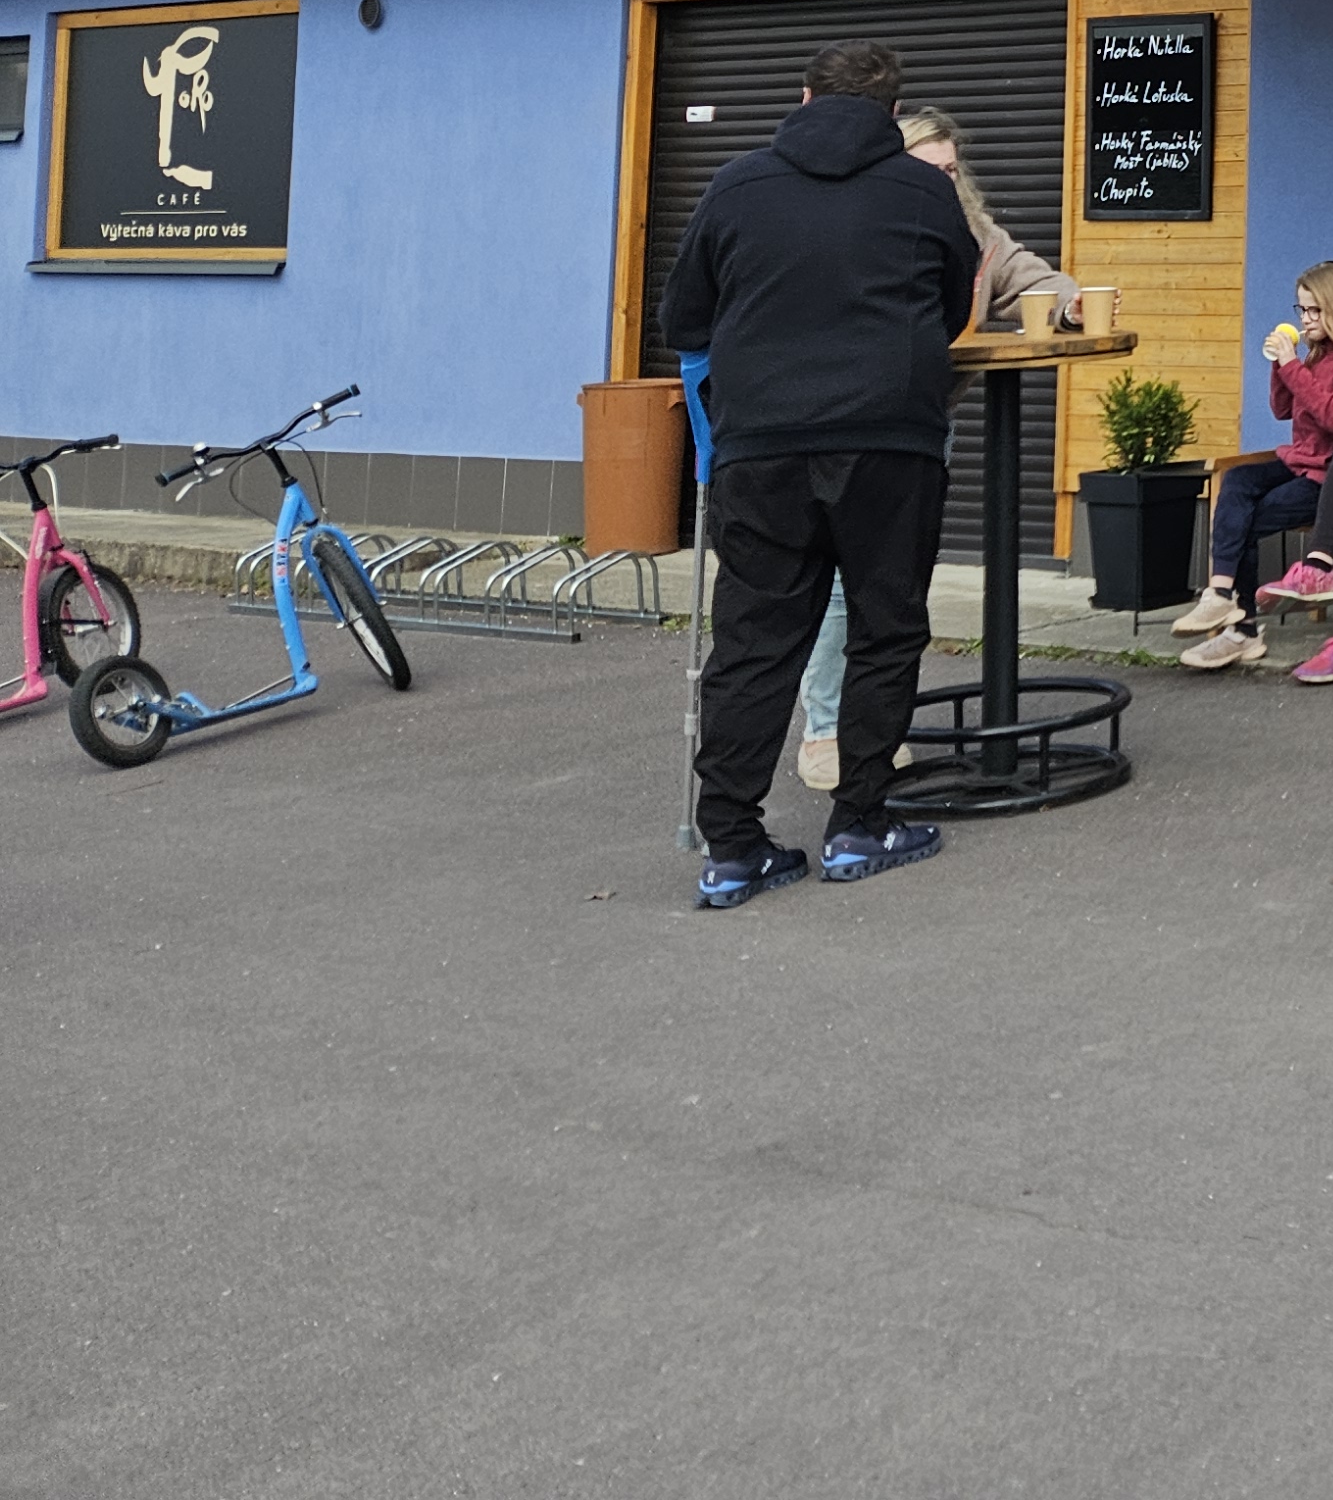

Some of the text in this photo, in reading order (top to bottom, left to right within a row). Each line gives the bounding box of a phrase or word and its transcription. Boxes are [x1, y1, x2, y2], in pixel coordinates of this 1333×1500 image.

[1102, 34, 1194, 61] Horká Nutella
[1101, 81, 1139, 107] Horká
[1100, 131, 1137, 155] Horký
[156, 192, 201, 206] CAFÉ
[1100, 177, 1153, 204] Chupito
[100, 220, 248, 242] Výtečná káva pro vás
